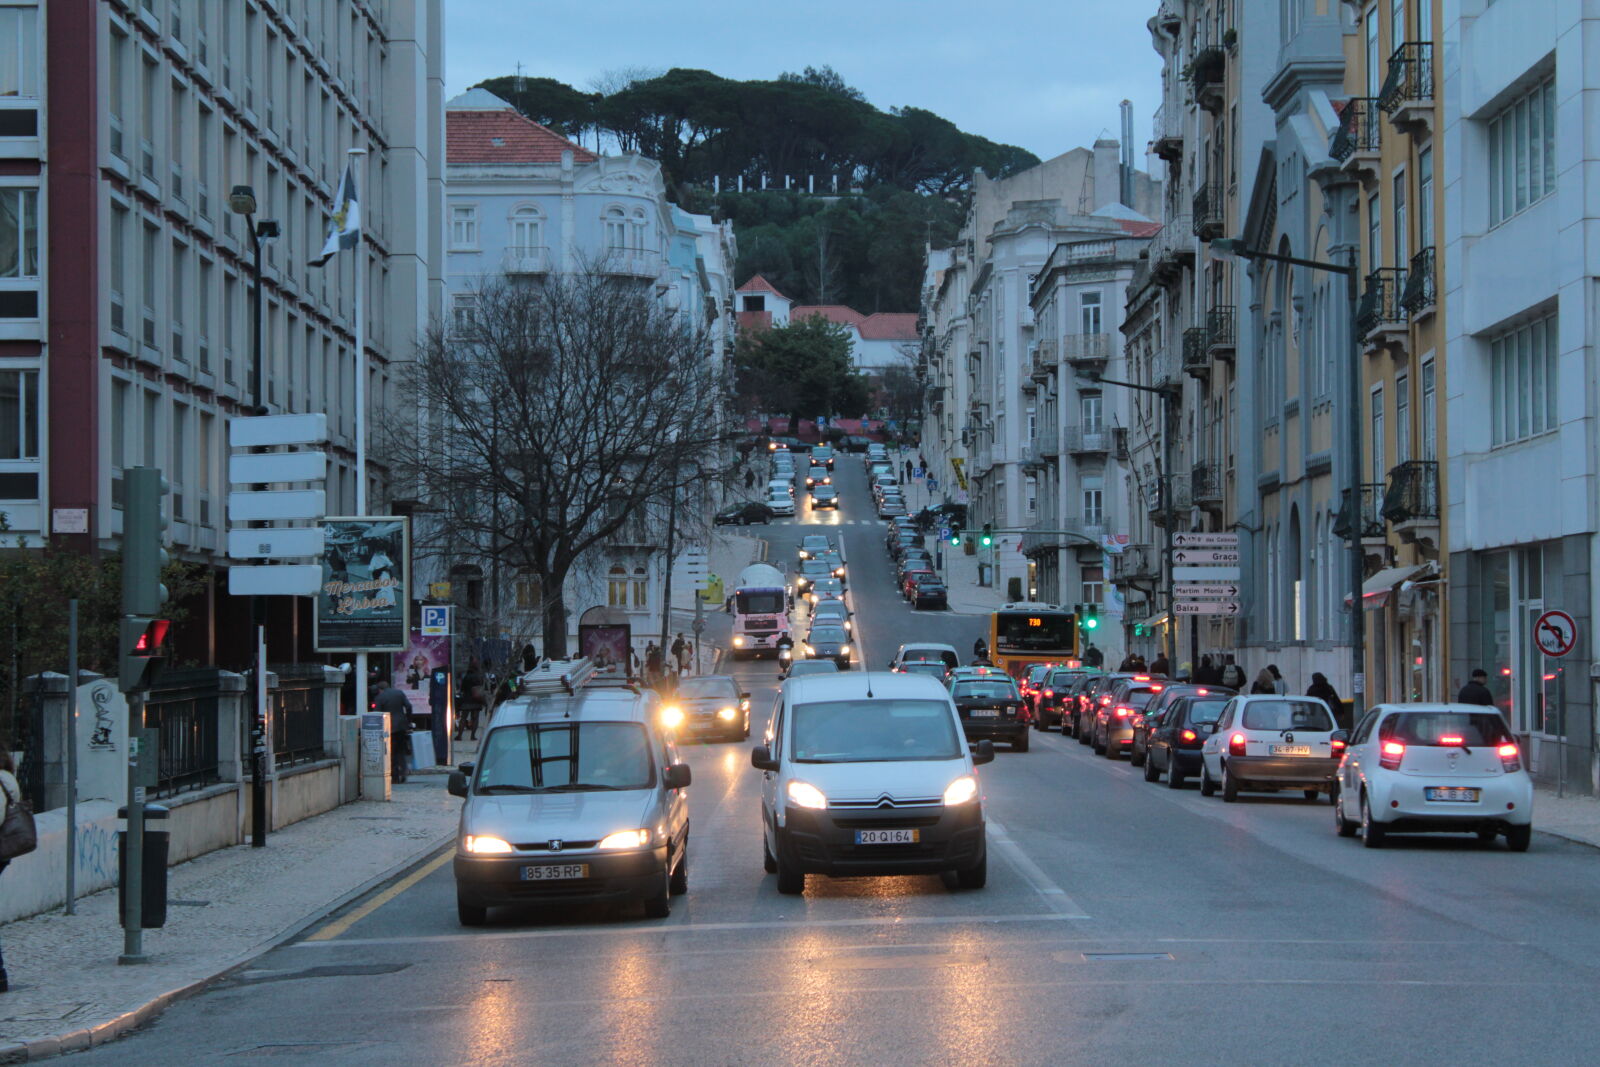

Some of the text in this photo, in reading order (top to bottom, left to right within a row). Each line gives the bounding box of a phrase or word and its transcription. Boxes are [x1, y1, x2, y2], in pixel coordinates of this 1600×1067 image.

[942, 528, 950, 540] P
[1212, 552, 1237, 561] Graça
[324, 576, 399, 598] Mercados
[1176, 604, 1199, 612] Baixa
[427, 609, 438, 625] P
[1029, 618, 1041, 626] 730
